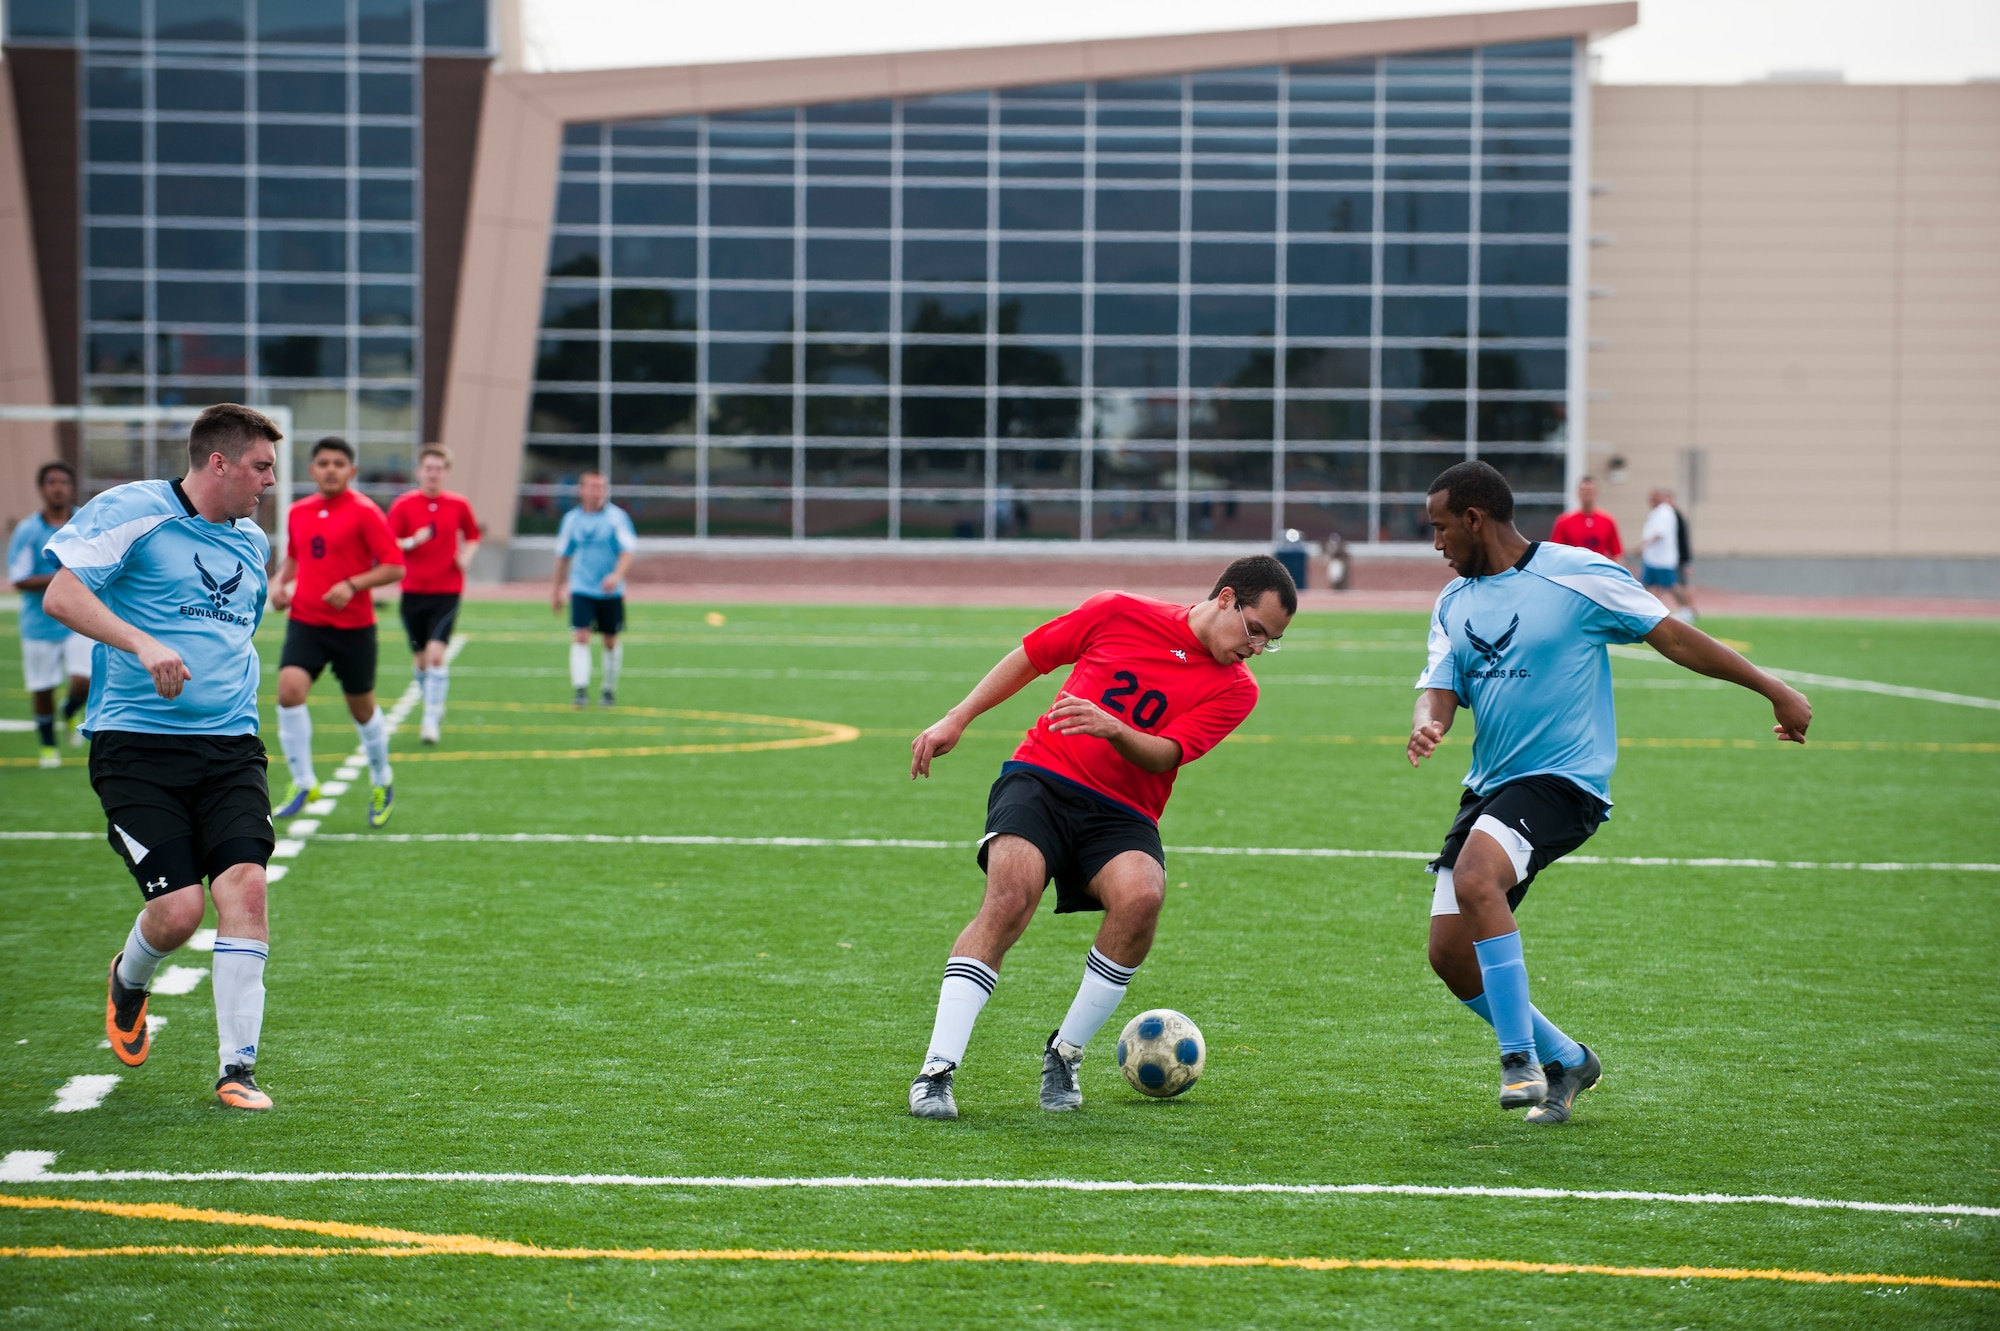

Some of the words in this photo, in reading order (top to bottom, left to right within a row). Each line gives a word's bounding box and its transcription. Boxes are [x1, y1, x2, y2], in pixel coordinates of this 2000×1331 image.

[311, 535, 326, 560] 8
[180, 605, 235, 623] EDWARDS
[1509, 668, 1532, 679] F.C.
[1101, 670, 1168, 729] 20
